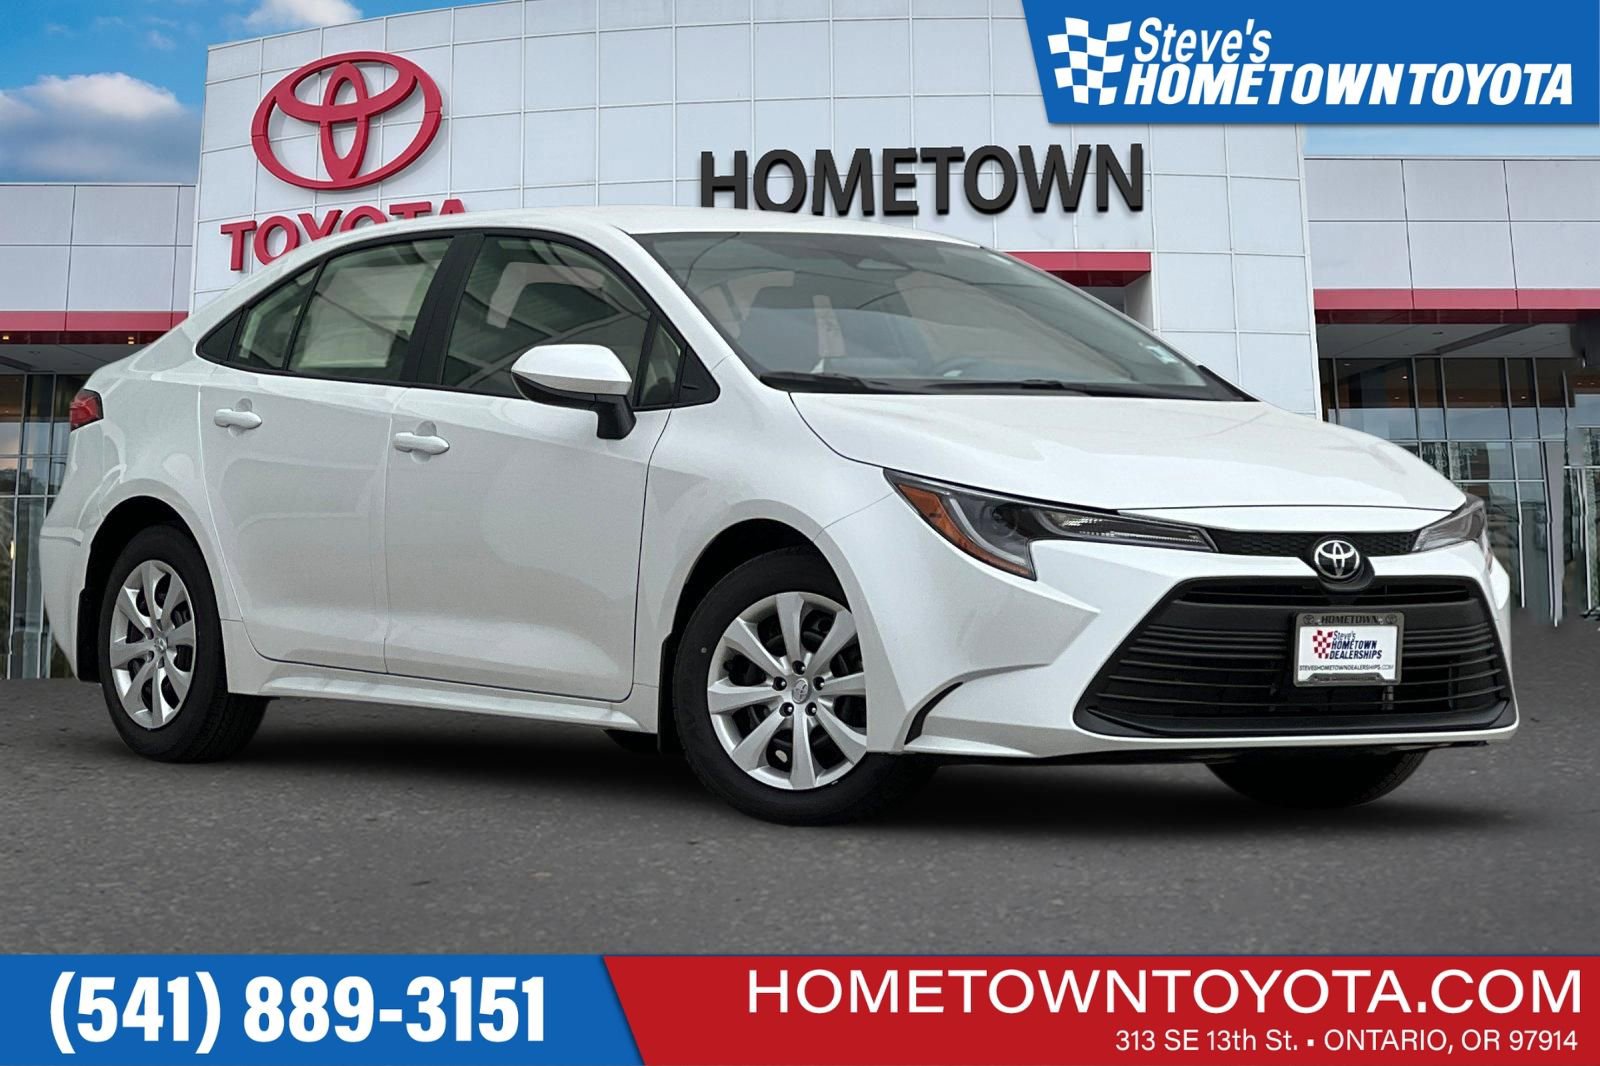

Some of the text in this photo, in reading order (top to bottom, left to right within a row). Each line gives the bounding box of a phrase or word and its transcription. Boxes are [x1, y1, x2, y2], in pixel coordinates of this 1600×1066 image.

[699, 143, 1145, 215] HOMETOWN
[220, 198, 466, 271] TOY
[1320, 615, 1379, 625] HOMETOWN
[1332, 630, 1357, 641] Steve's
[1331, 640, 1378, 650] HOMETOWN
[1329, 650, 1383, 660] DEALERSHIPS
